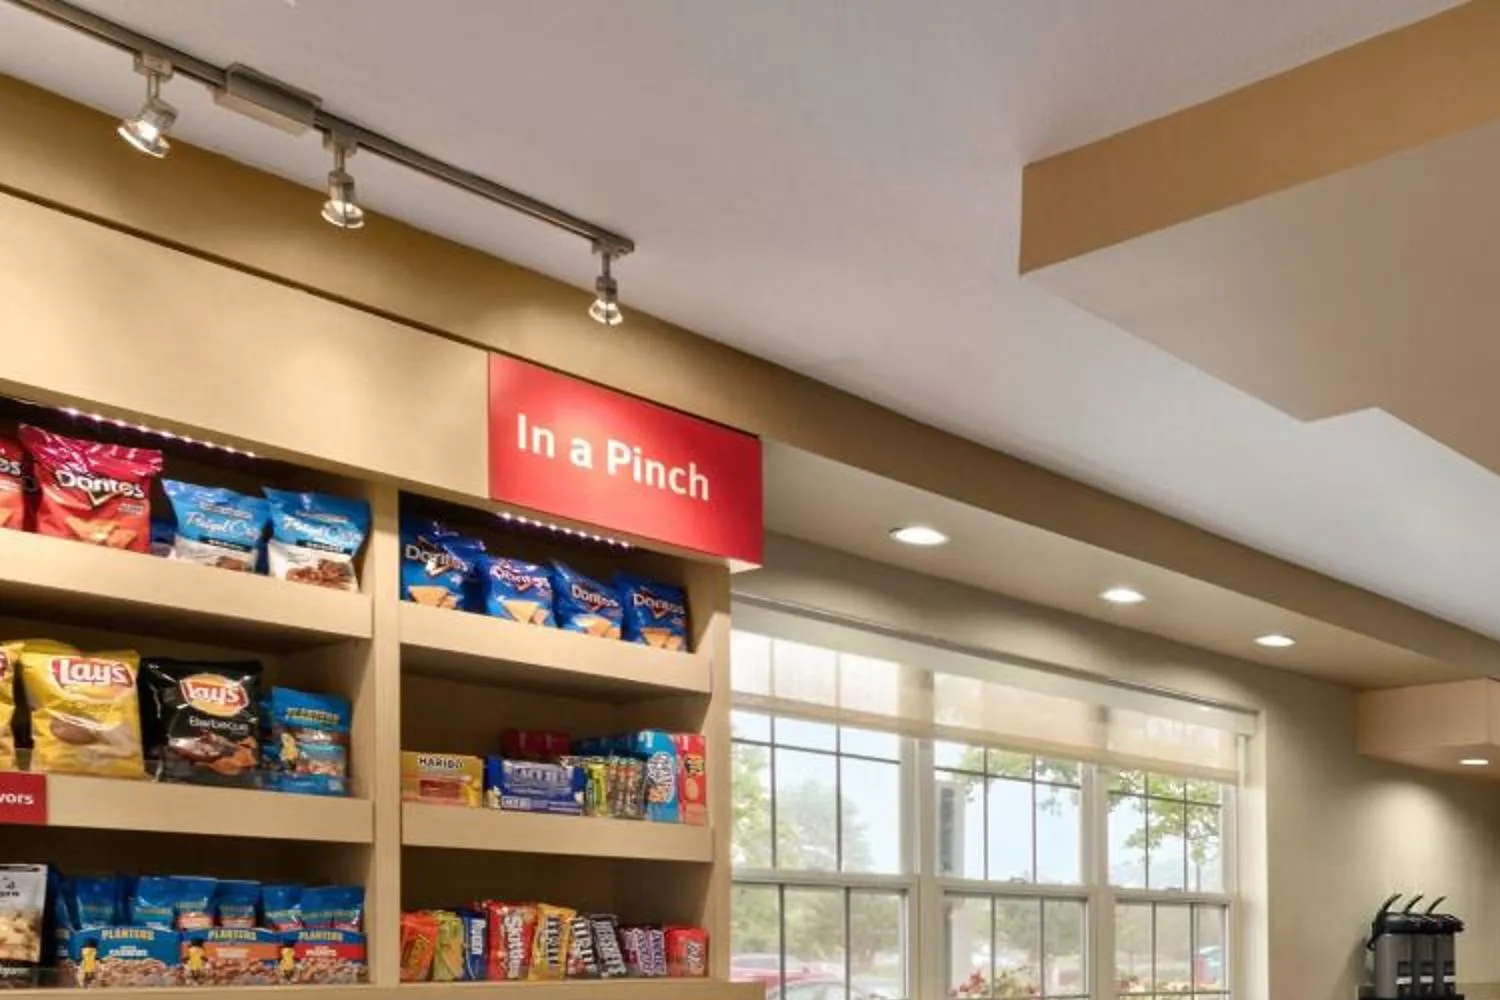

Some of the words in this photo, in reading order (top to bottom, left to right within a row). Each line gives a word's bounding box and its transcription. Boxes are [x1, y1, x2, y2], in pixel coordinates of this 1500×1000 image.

[517, 412, 556, 460] In
[569, 436, 593, 470] a
[606, 438, 710, 501] Pinch
[55, 468, 145, 499] Doritos
[418, 756, 465, 769] HARIBO
